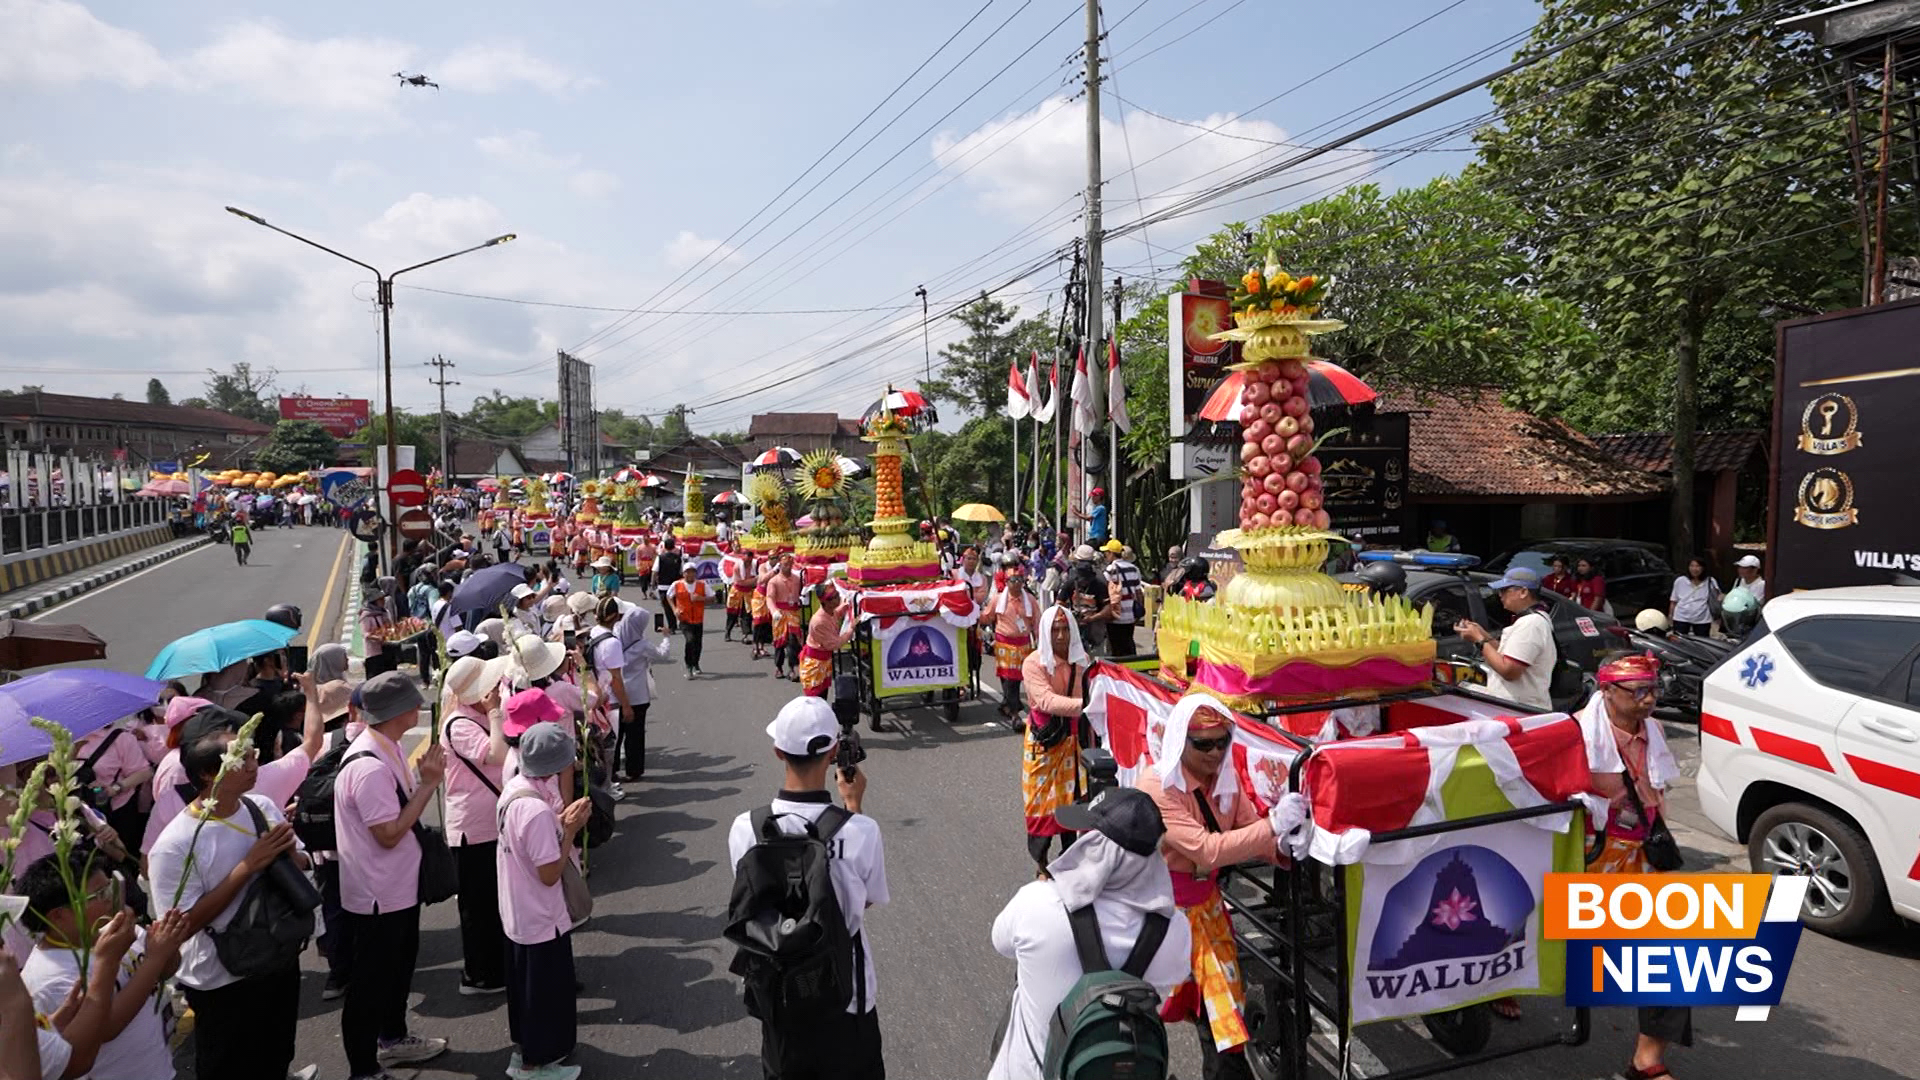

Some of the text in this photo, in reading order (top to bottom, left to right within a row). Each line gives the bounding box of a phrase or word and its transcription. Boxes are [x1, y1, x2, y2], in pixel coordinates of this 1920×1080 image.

[1854, 550, 1920, 571] VILLA'S
[888, 666, 954, 681] WALUBI
[1366, 946, 1526, 999] WALUBI
